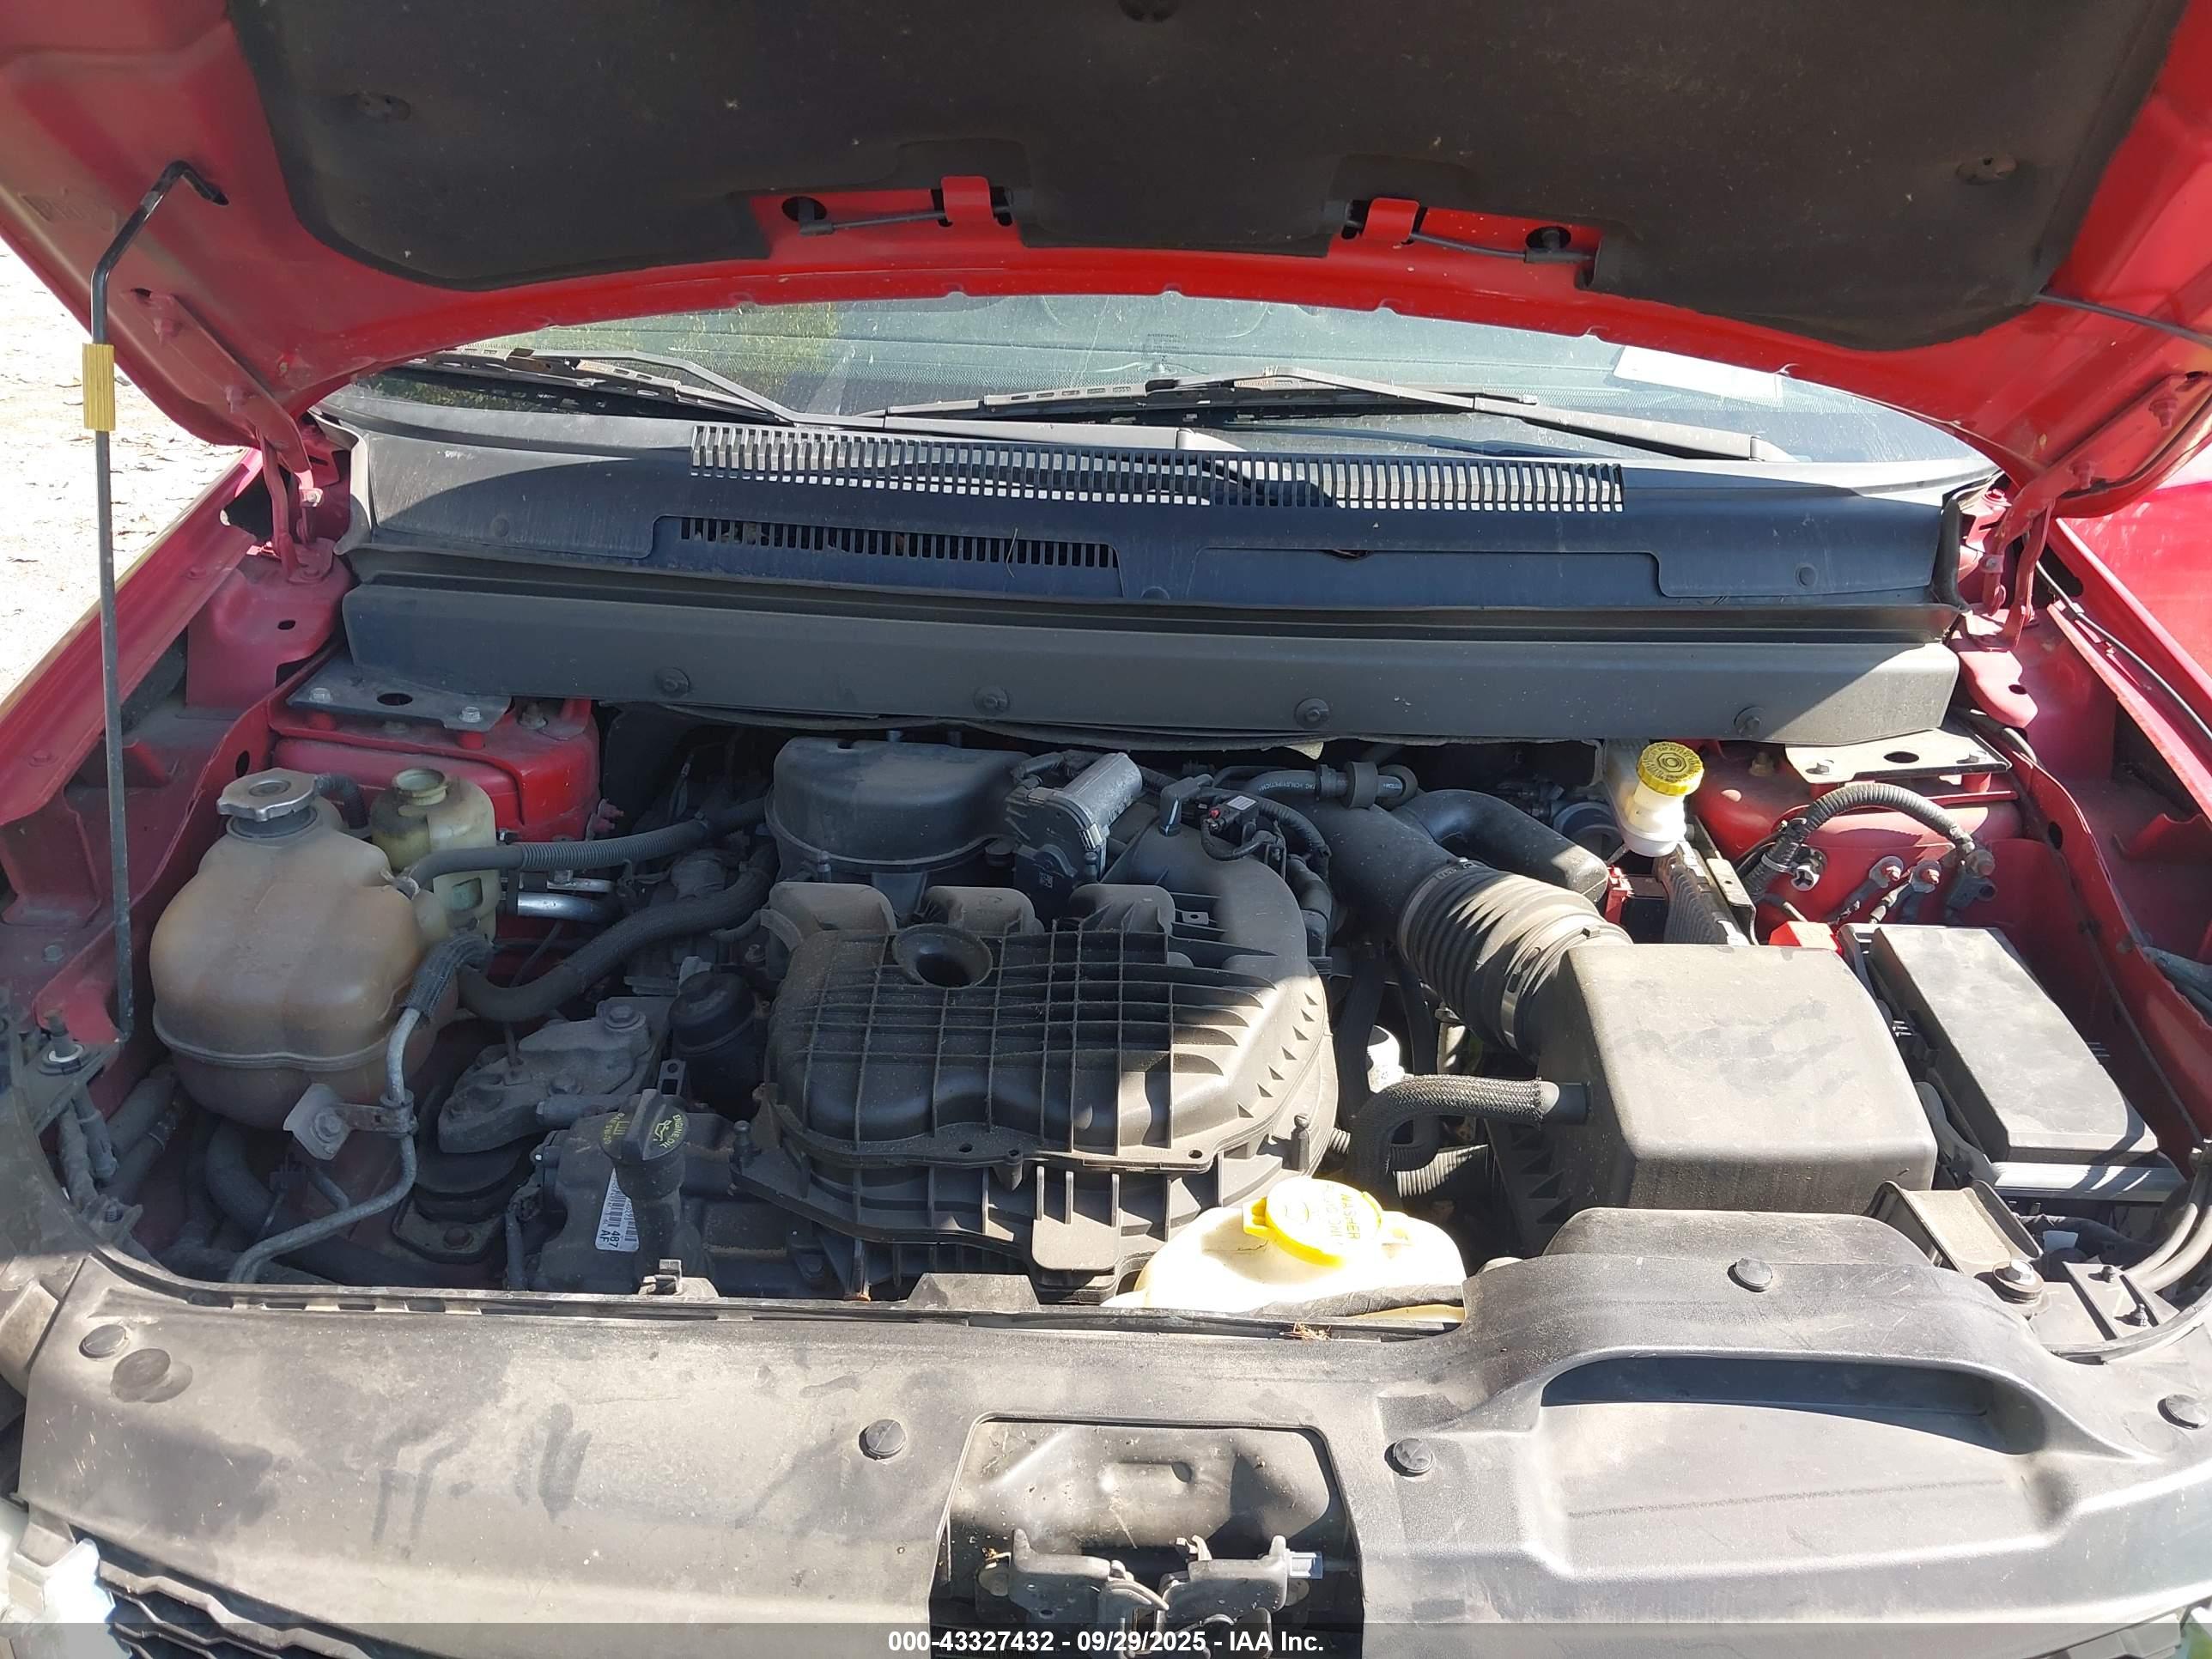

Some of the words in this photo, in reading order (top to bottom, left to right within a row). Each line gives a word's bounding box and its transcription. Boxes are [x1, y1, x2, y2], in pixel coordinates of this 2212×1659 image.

[672, 1114, 684, 1138] ENGINE
[659, 1138, 675, 1148] OIL
[1340, 1194, 1361, 1239] WASHER
[599, 1229, 611, 1243] AF
